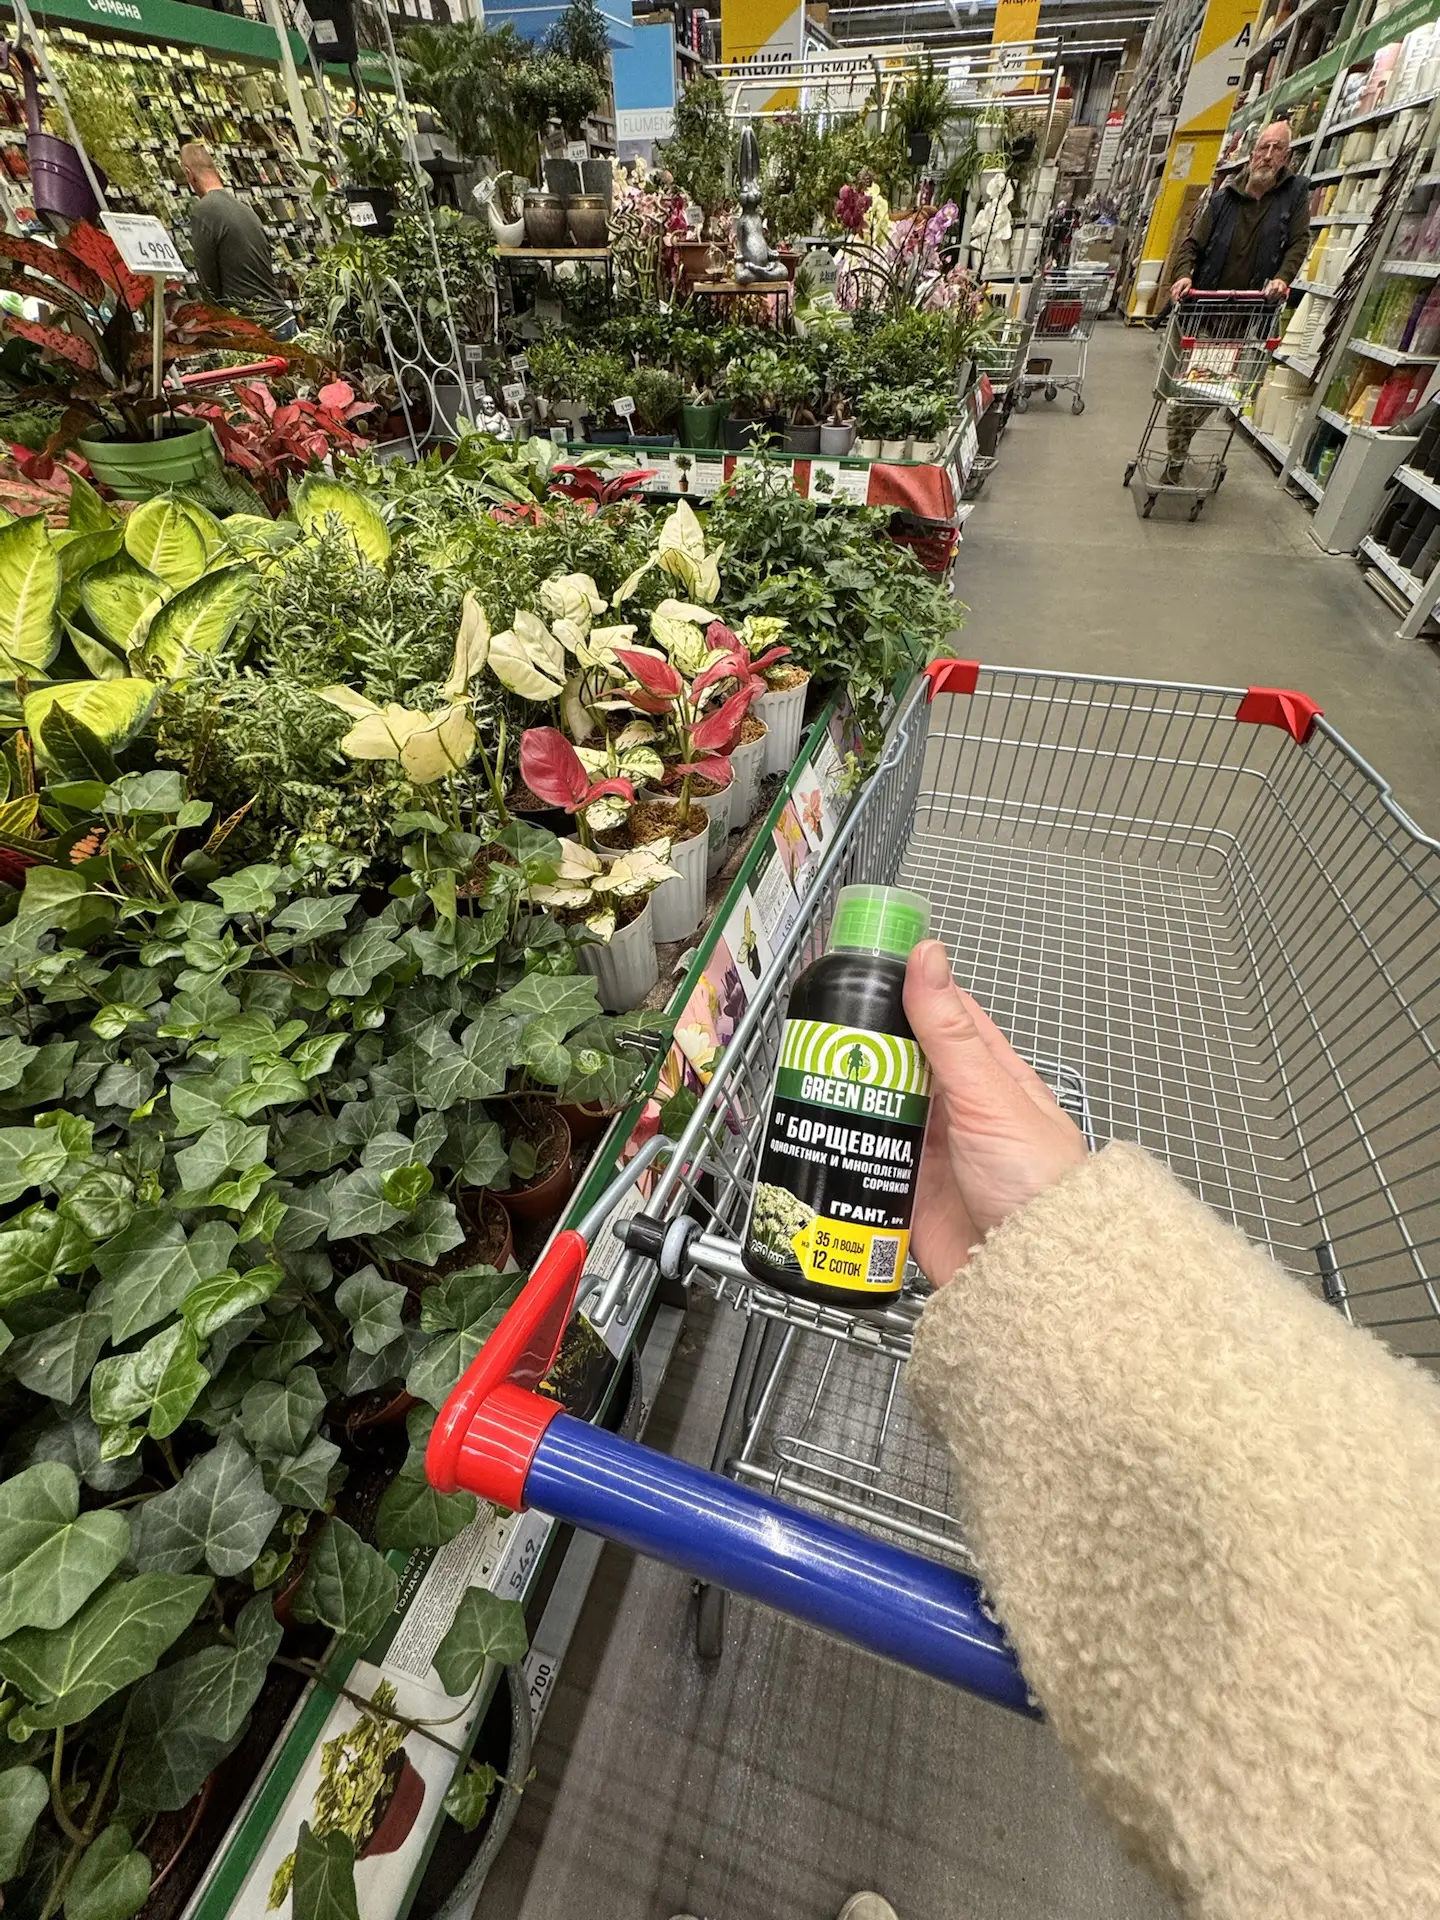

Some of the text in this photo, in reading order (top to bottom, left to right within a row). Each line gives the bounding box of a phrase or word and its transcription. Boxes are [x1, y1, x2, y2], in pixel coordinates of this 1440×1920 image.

[87, 0, 142, 20] Семена
[729, 53, 792, 77] АКЦИЯ
[623, 115, 668, 132] FLUMEN
[801, 1074, 906, 1119] GREEN BELT
[787, 1116, 914, 1167] БОРЩЕВИКА,
[770, 1138, 912, 1180] ОДНОЛЕТНИХ И МНОГОЛЕТНИХ
[863, 1176, 910, 1194] СОРНЯКОВ
[830, 1200, 889, 1226] ГРАНТ,
[751, 1239, 768, 1257] 250
[815, 1230, 831, 1248] 35
[812, 1249, 828, 1270] 12
[509, 1538, 536, 1590] 549
[393, 1560, 426, 1615] Голден
